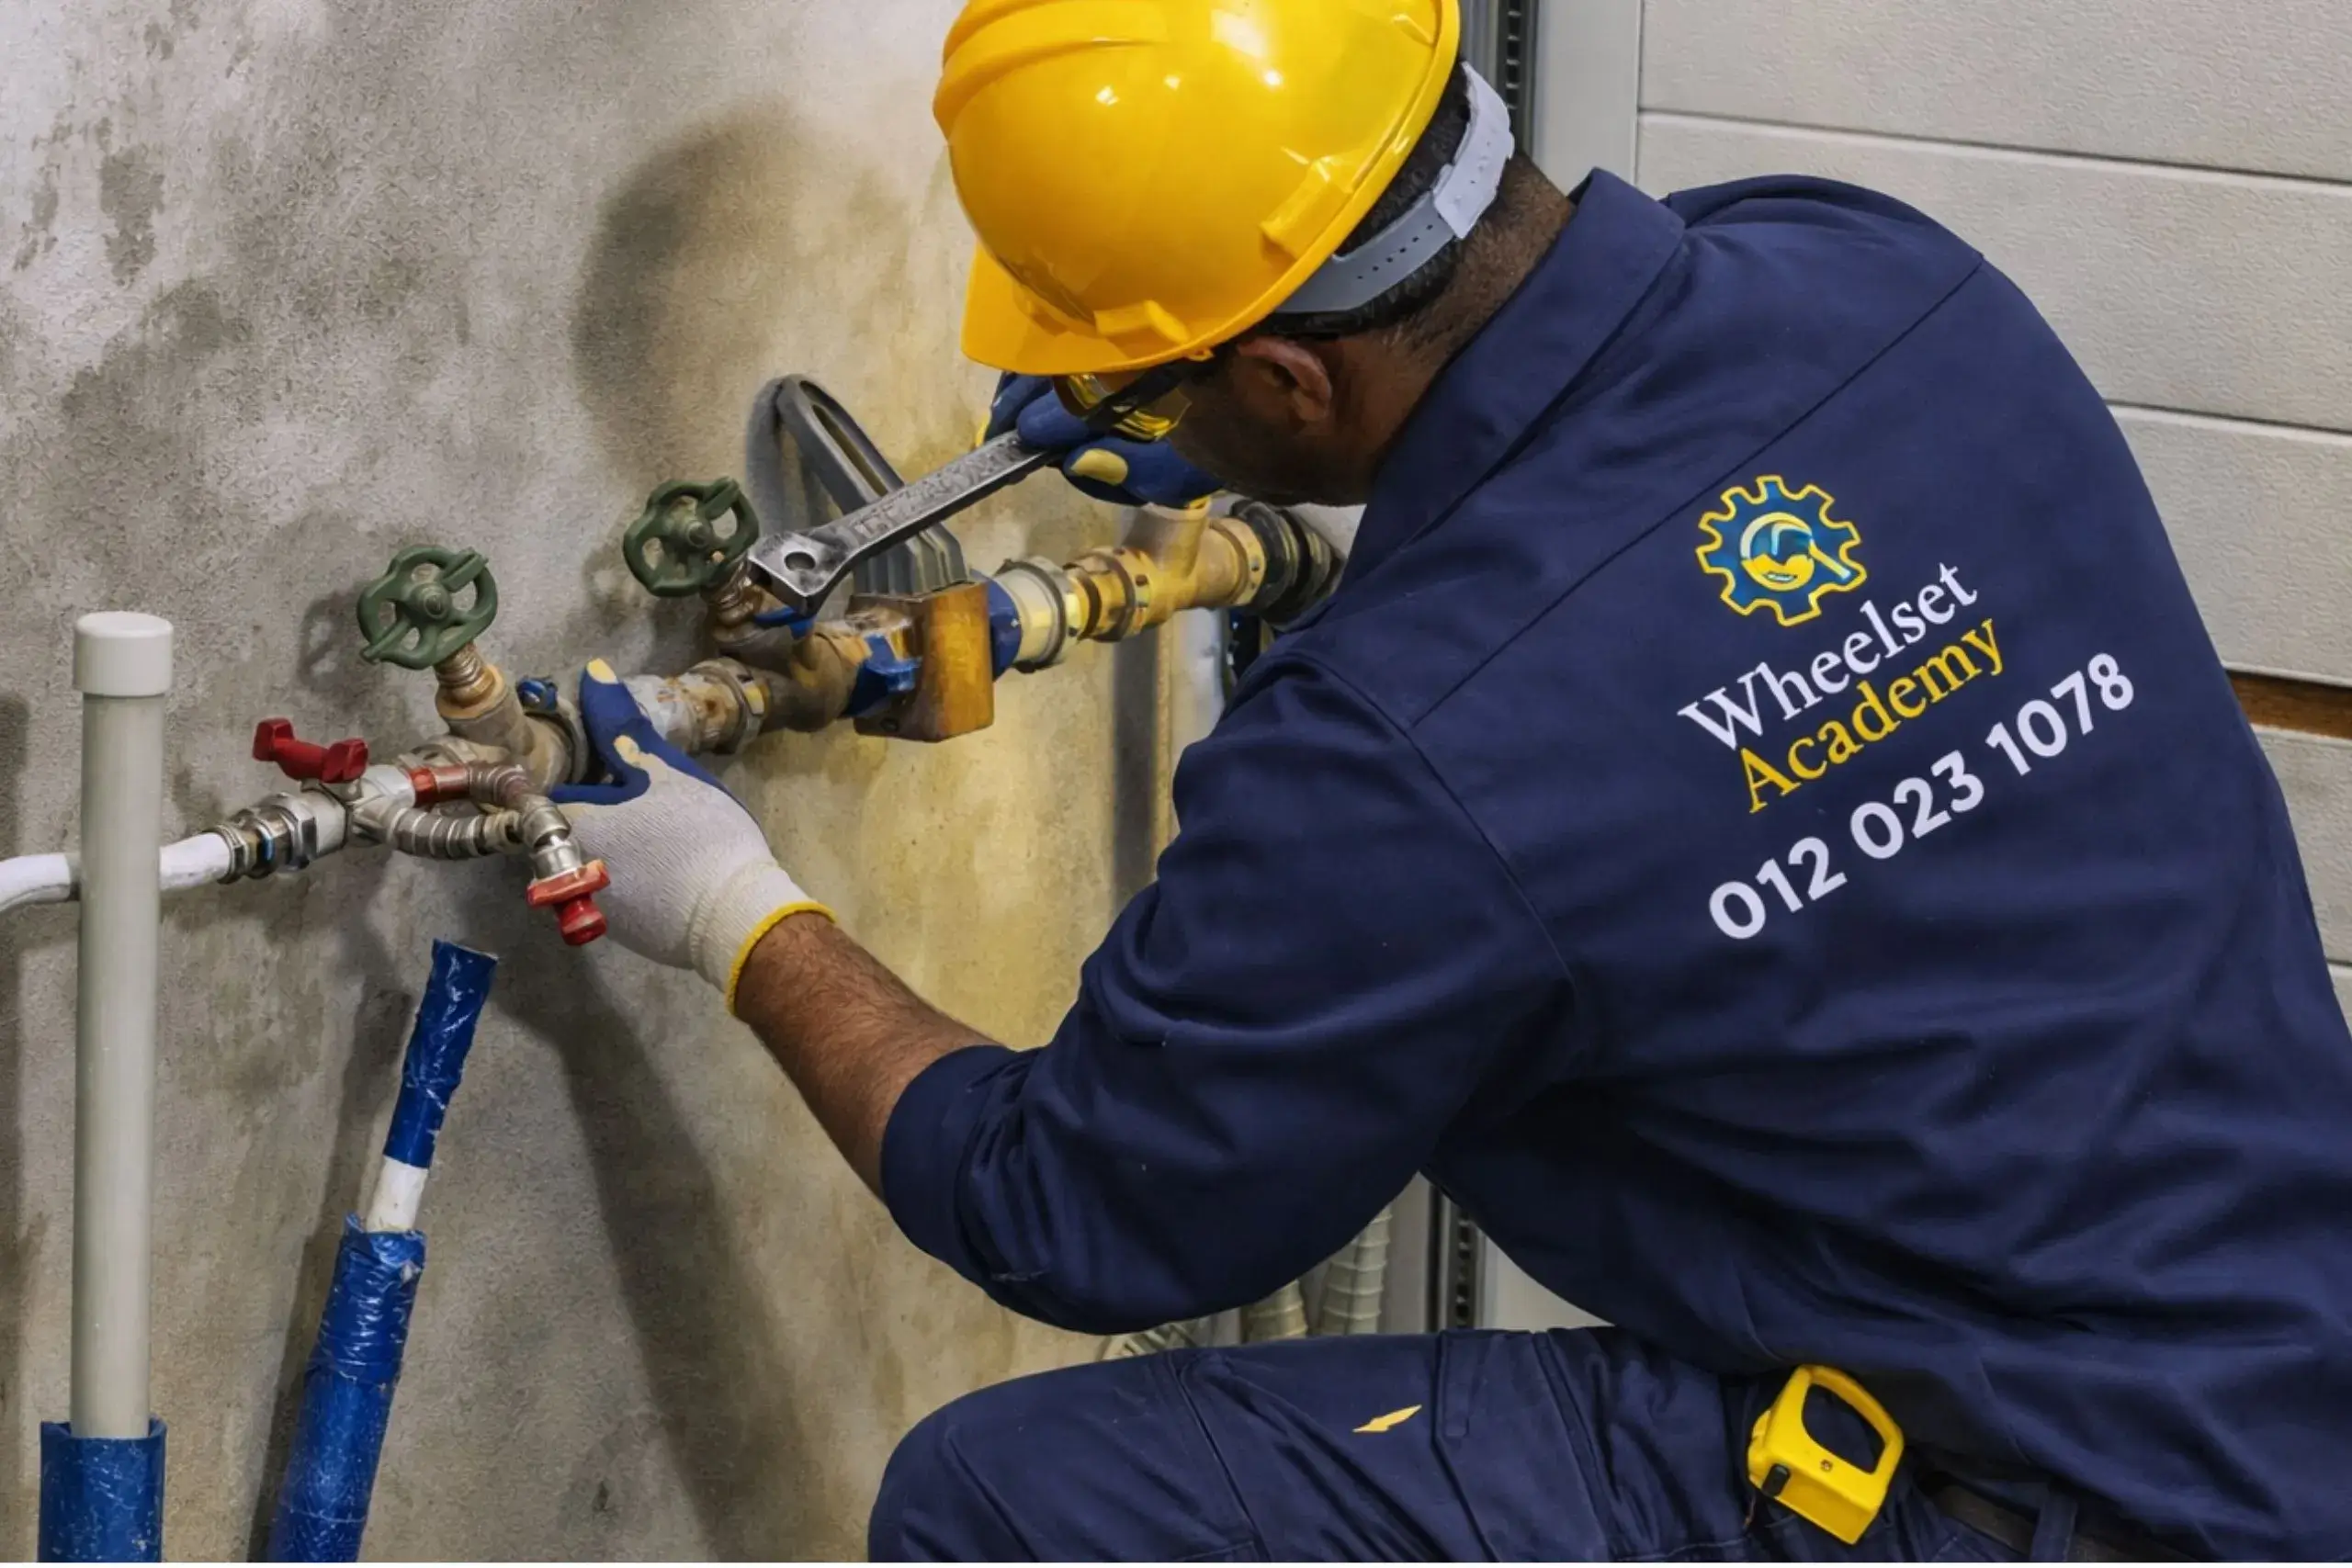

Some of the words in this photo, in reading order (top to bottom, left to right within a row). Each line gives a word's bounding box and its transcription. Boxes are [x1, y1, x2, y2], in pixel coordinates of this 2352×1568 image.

[1677, 562, 1978, 751] Wheelset
[1739, 617, 2004, 813] Academy
[1709, 836, 1848, 939] 012
[1849, 750, 1984, 860] 023
[1986, 652, 2134, 776] 1078
